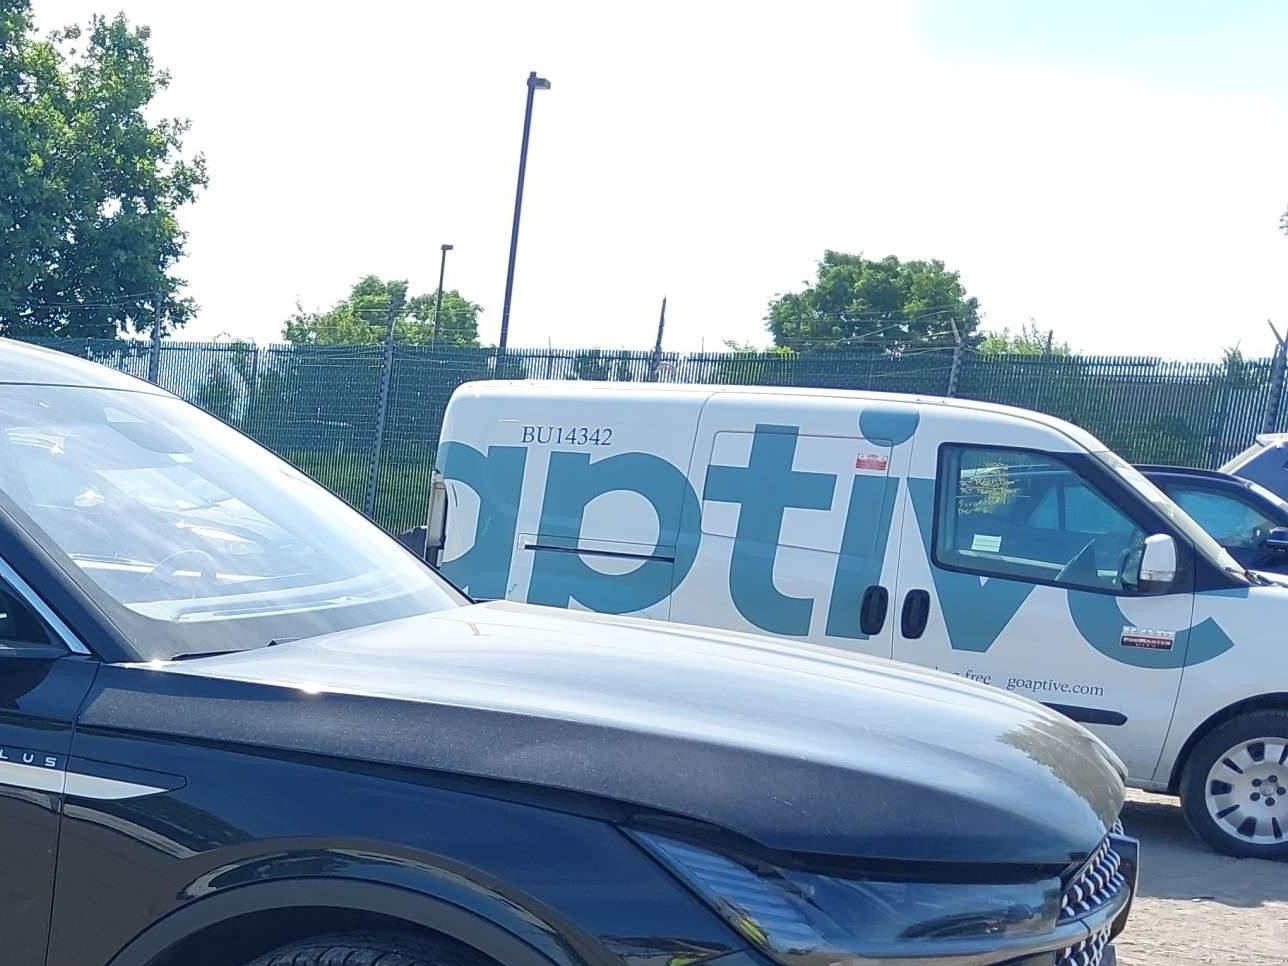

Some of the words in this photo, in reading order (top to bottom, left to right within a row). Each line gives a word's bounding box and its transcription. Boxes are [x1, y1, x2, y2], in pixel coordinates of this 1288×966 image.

[521, 425, 613, 446] BU14342
[965, 669, 992, 685] free
[1006, 676, 1104, 697] goaptive.com
